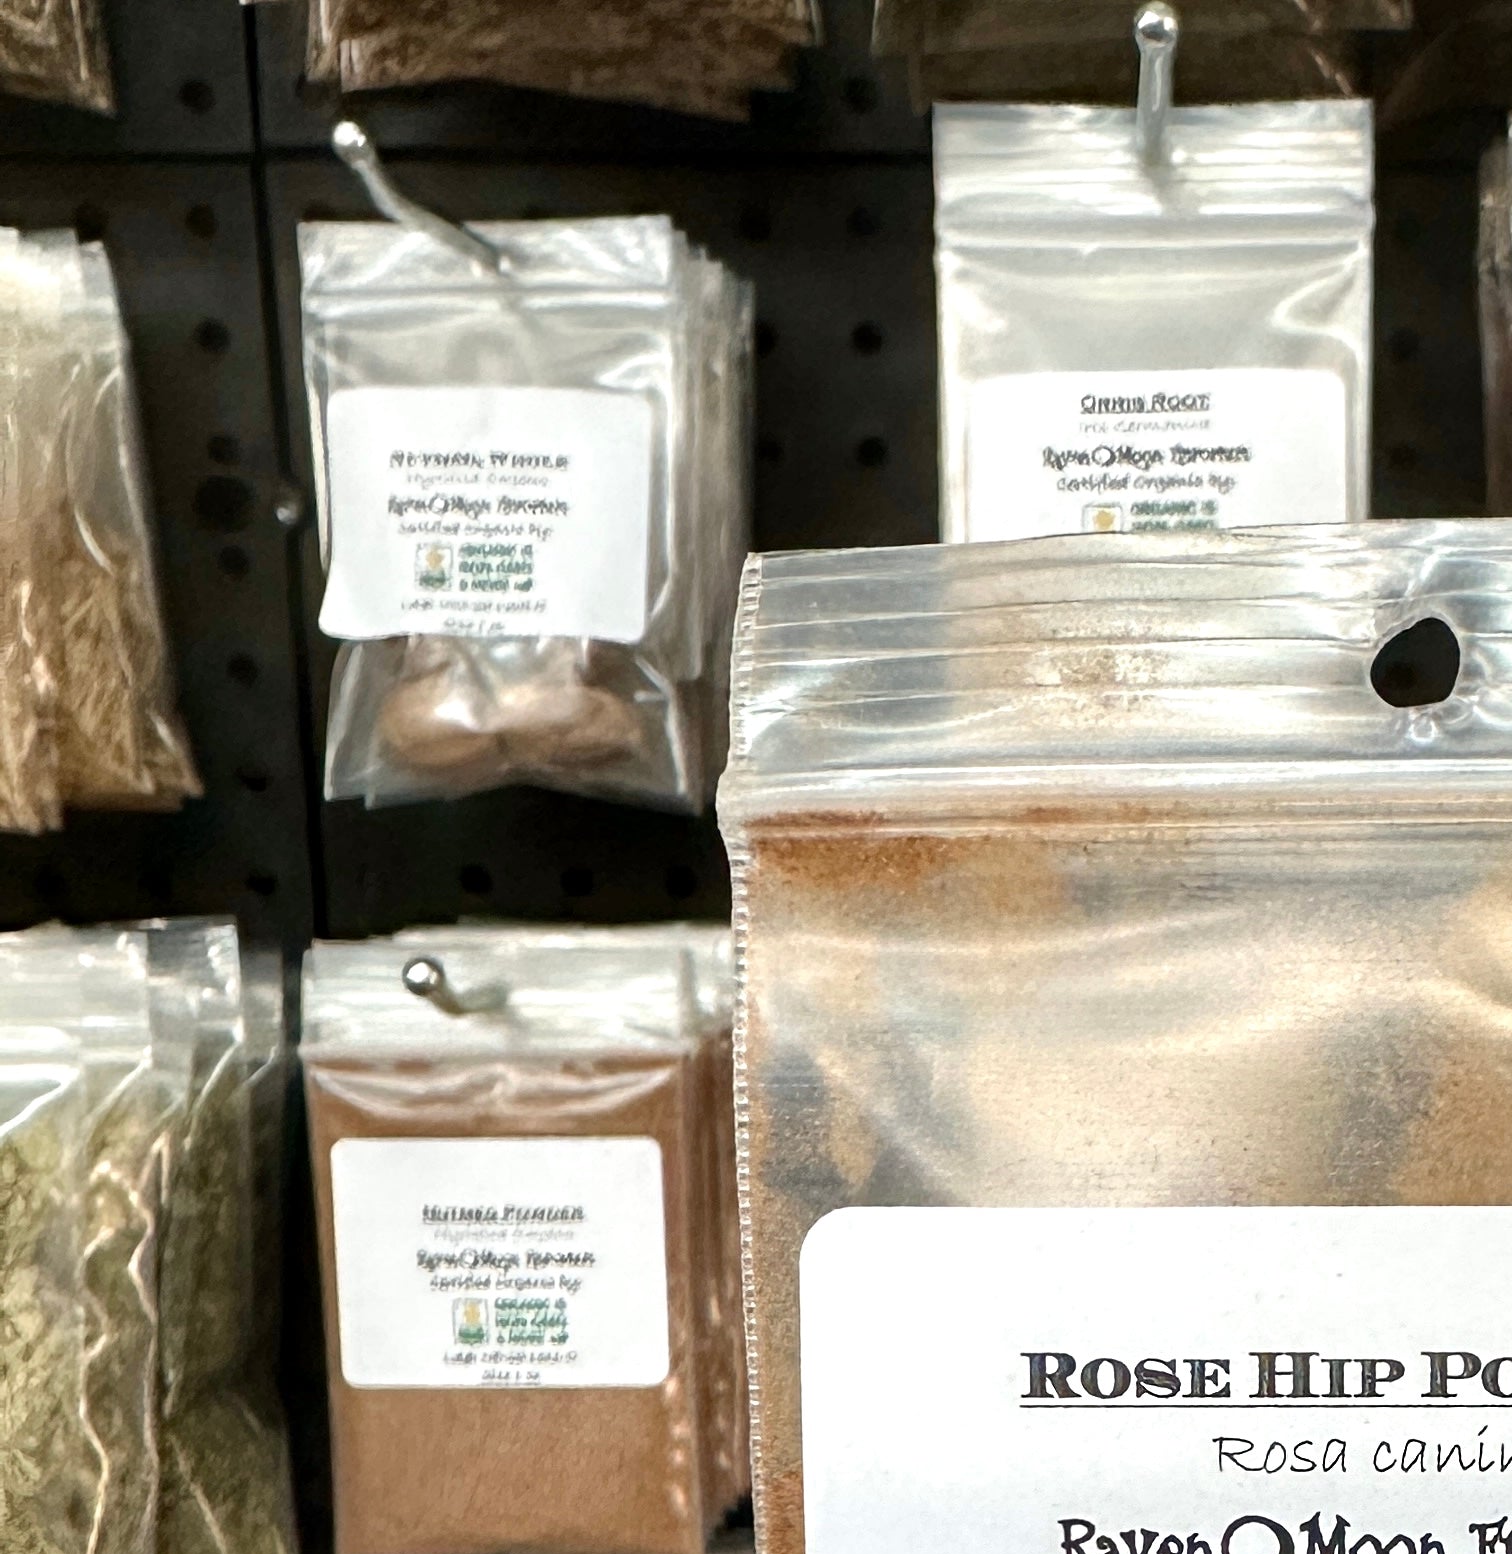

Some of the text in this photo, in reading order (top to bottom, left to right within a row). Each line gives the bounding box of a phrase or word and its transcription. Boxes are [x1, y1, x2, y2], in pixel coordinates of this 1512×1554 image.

[1021, 1352, 1230, 1399] ROSE
[1249, 1351, 1405, 1399] HIP
[1213, 1437, 1346, 1475] Rosa
